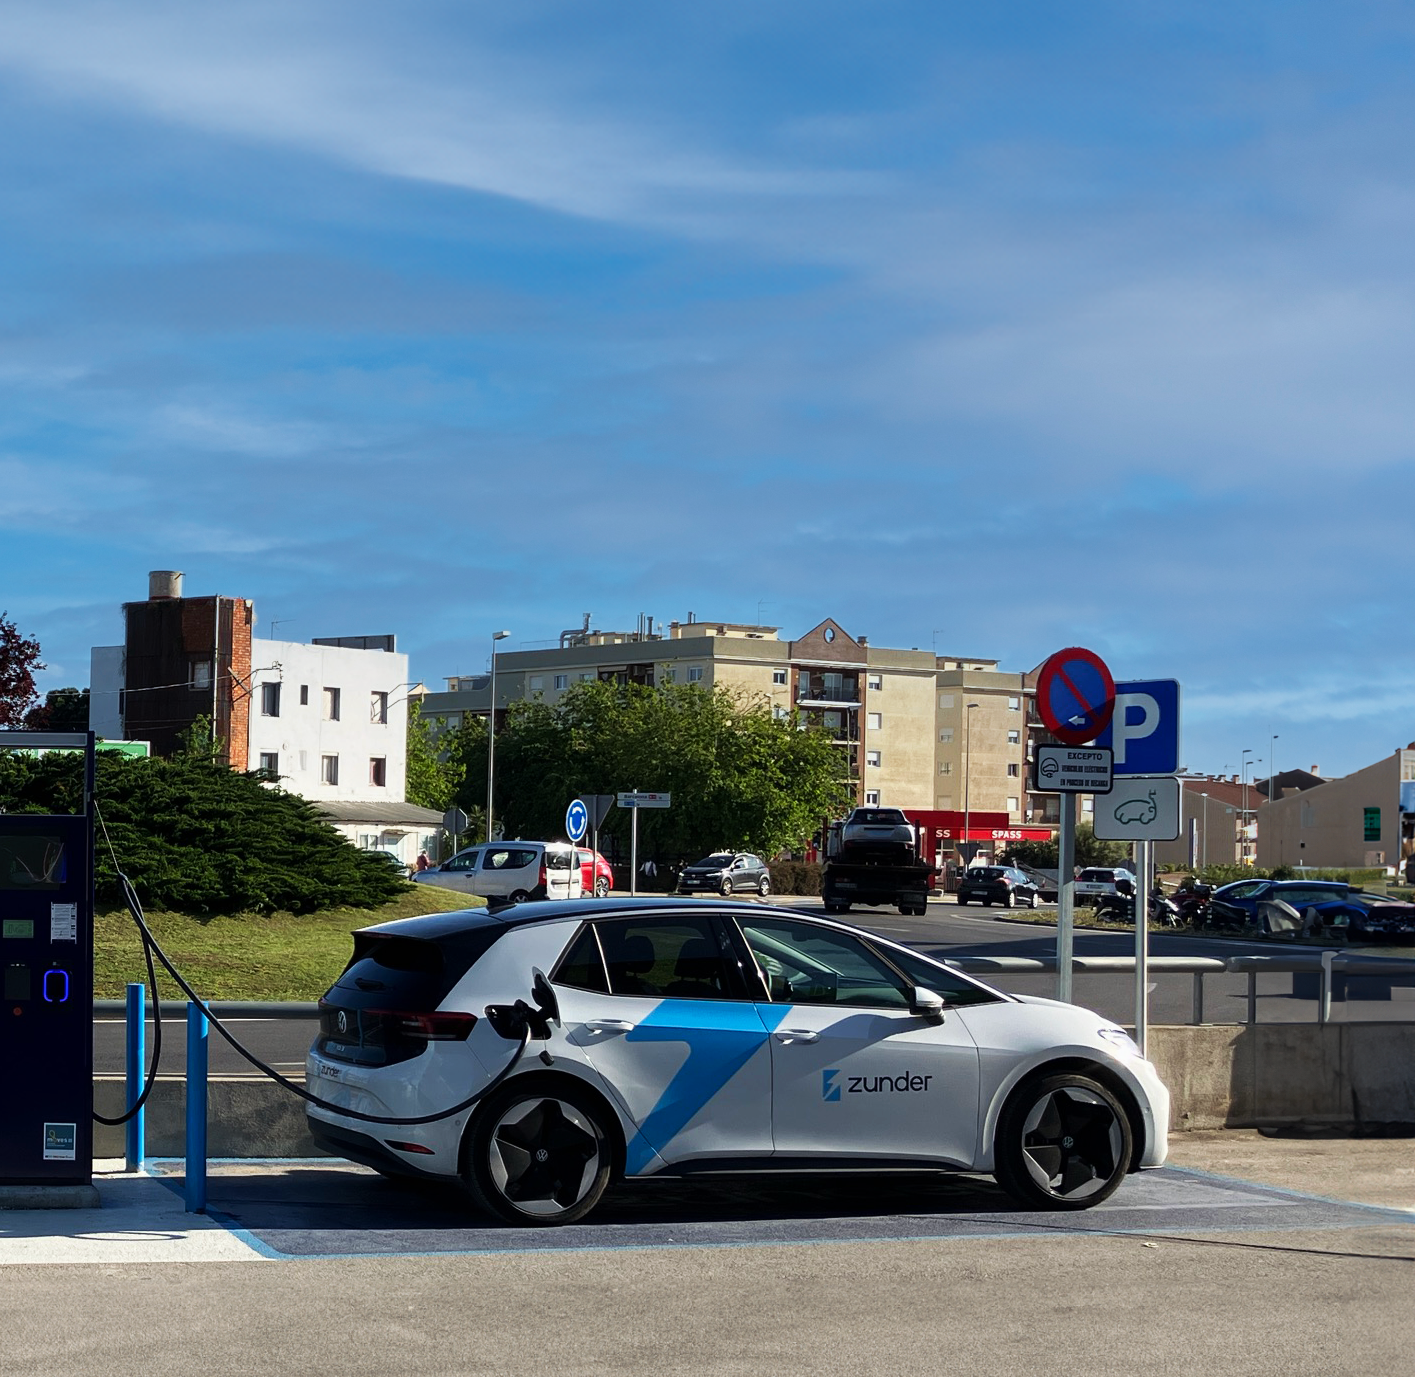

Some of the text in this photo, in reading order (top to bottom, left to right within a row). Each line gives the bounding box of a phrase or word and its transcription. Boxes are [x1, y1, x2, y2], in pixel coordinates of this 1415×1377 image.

[1112, 693, 1160, 764] P
[1067, 752, 1103, 760] EXCEPTO
[991, 830, 1022, 839] SPASS
[848, 1070, 933, 1093] zunder
